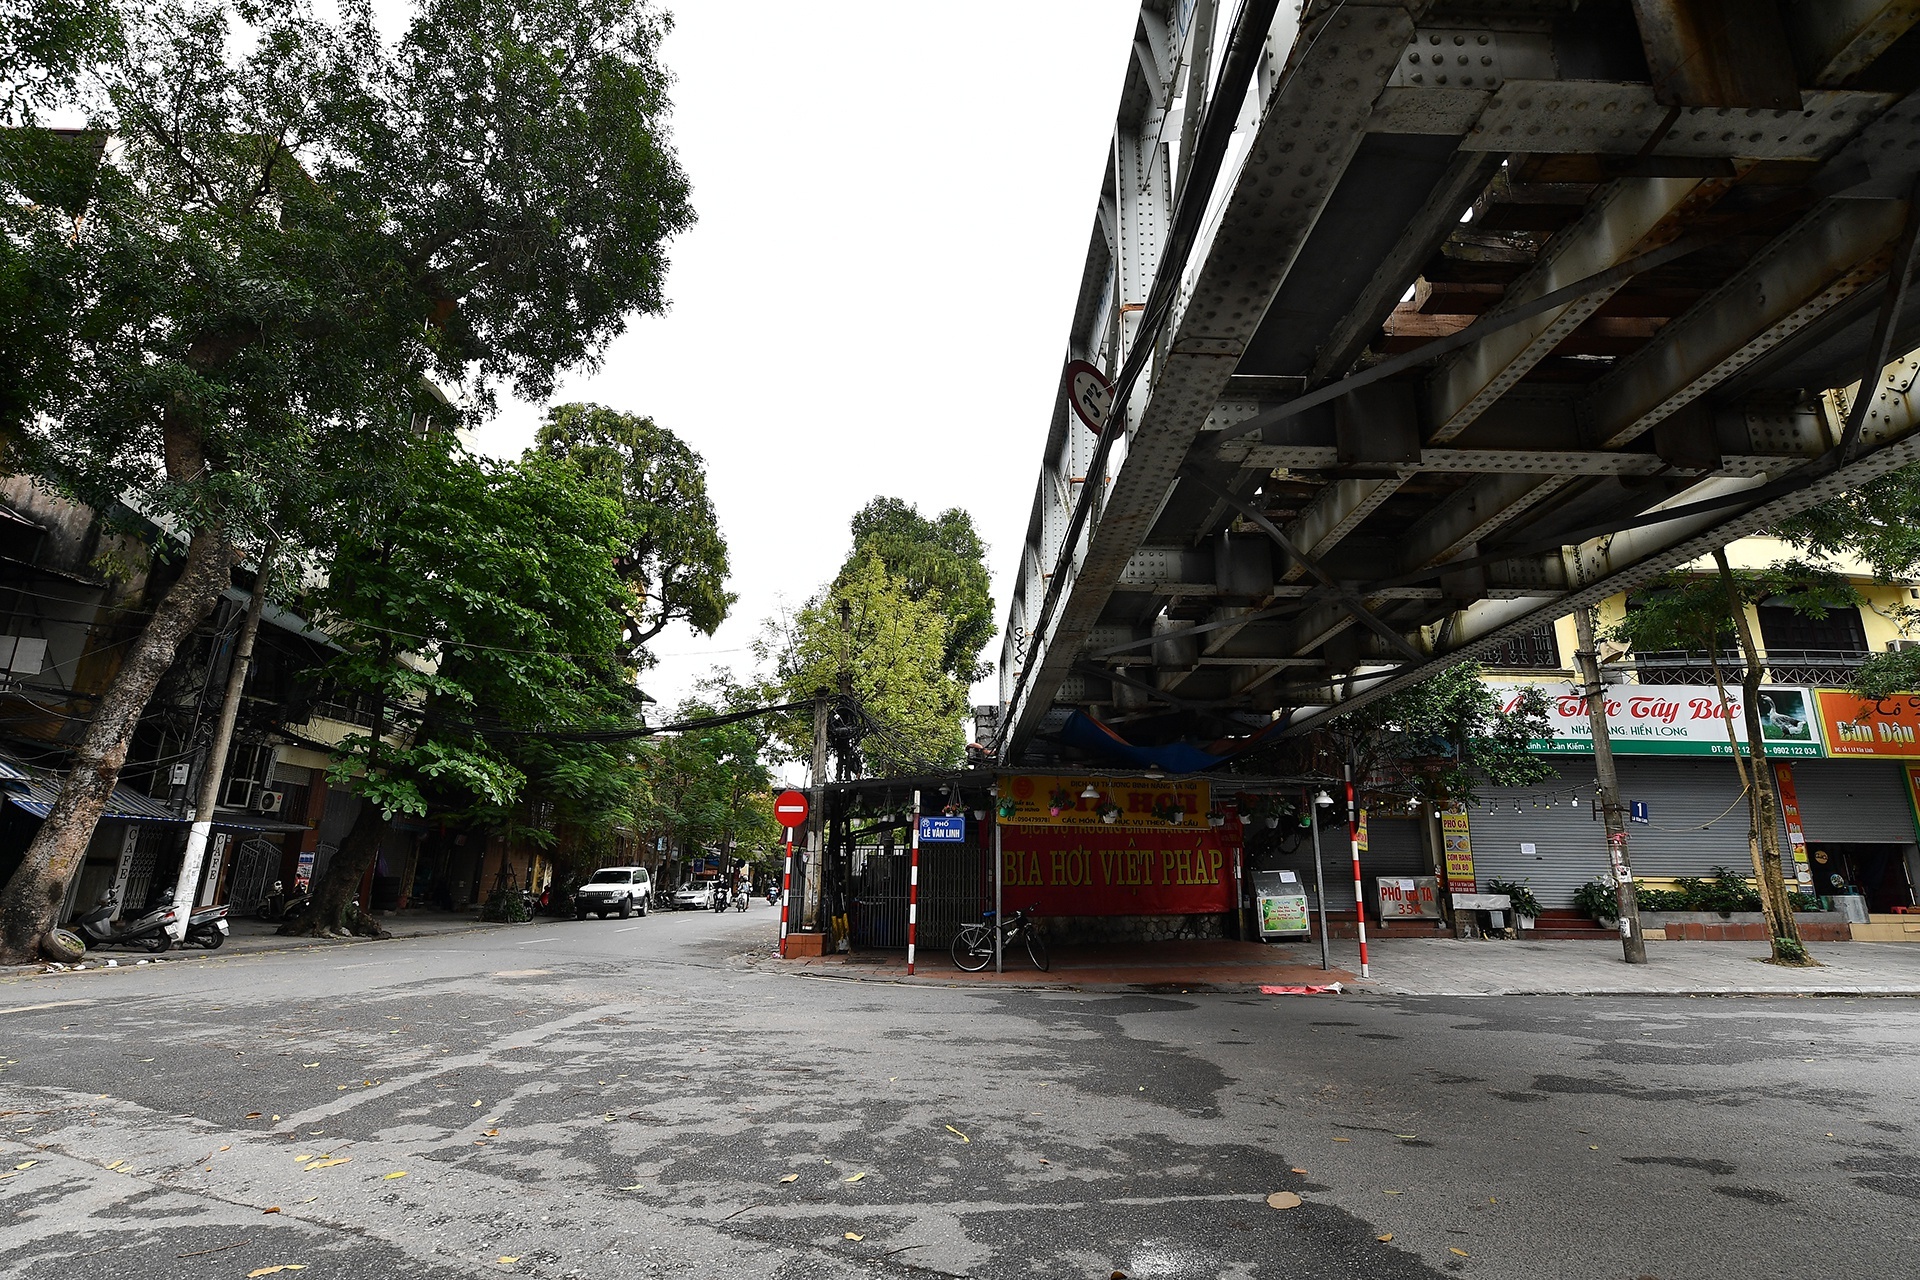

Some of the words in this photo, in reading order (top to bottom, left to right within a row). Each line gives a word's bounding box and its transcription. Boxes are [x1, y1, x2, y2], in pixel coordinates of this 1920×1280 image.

[1628, 697, 1680, 724] Tây
[1656, 727, 1688, 737] LONG
[1877, 721, 1916, 748] Đậu
[1790, 747, 1803, 755] 122
[1804, 747, 1817, 755] 034
[1637, 802, 1642, 817] 1
[946, 829, 960, 838] LINH
[119, 829, 138, 880] CAFE
[209, 834, 225, 880] CAFE
[1002, 850, 1044, 886] BIA
[1050, 844, 1093, 886] HƠI
[1098, 837, 1155, 895] VIỆT
[1160, 836, 1223, 884] PHÁP
[1420, 887, 1433, 901] TA
[1397, 903, 1423, 915] 35K
